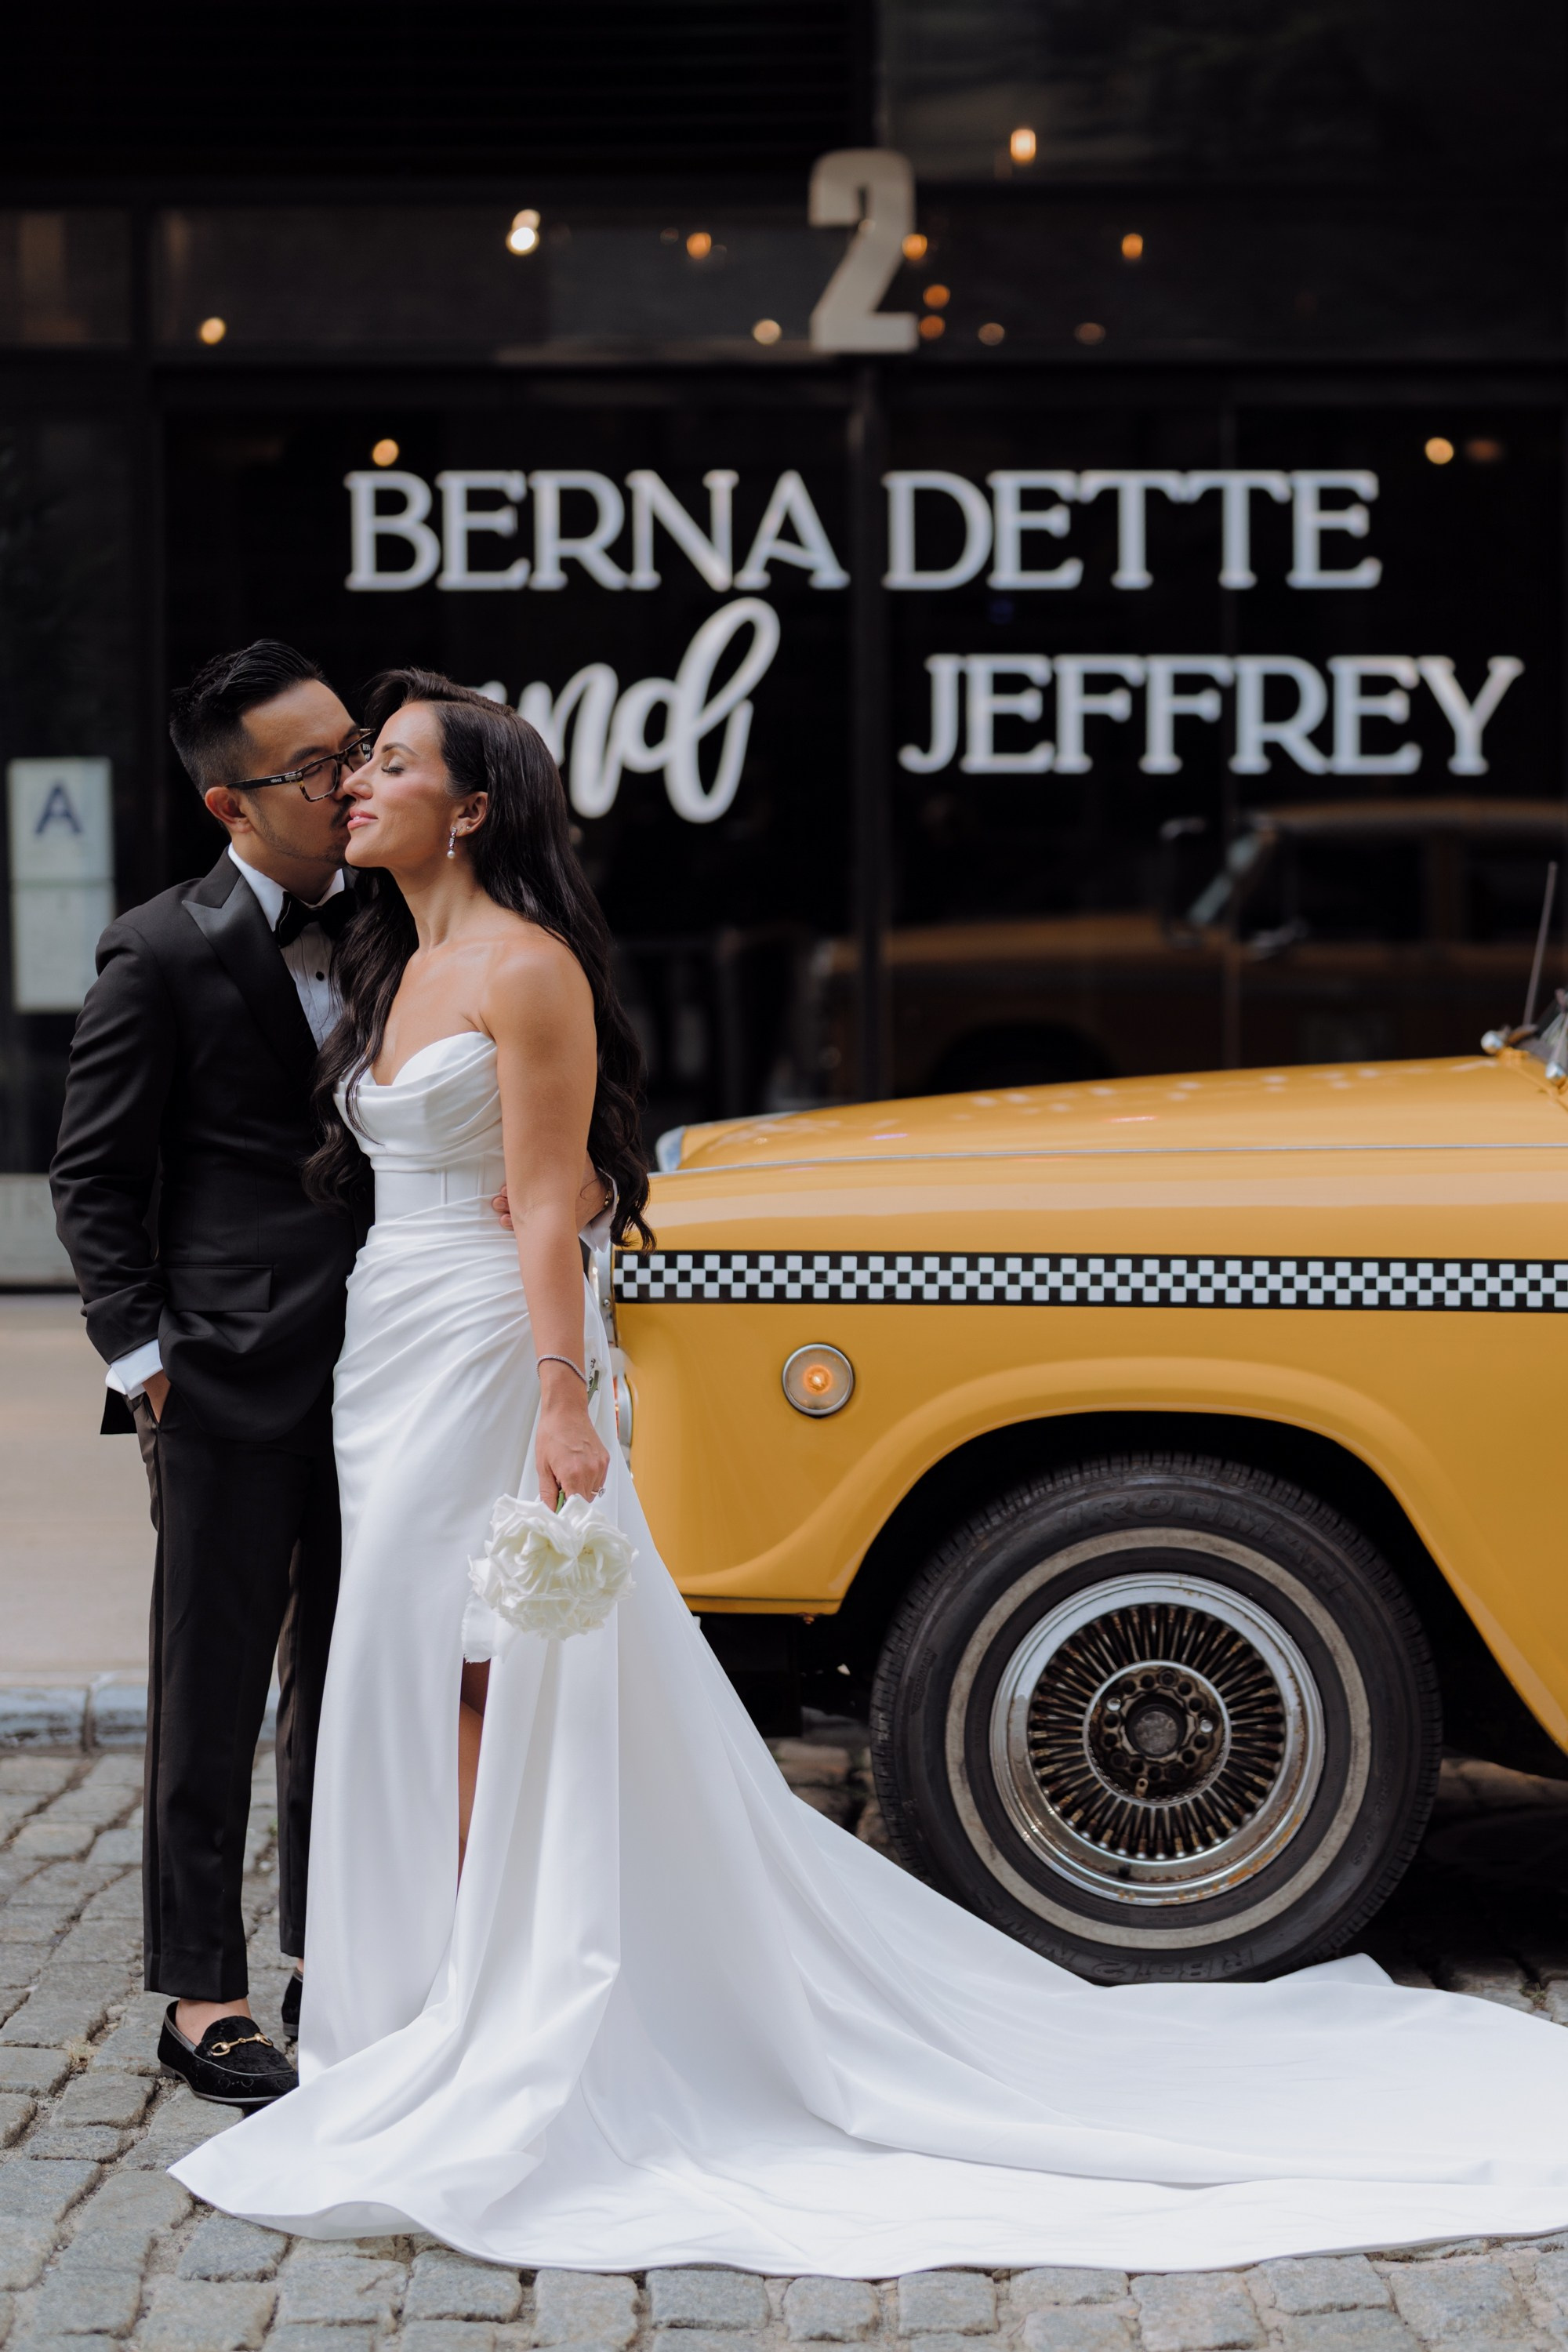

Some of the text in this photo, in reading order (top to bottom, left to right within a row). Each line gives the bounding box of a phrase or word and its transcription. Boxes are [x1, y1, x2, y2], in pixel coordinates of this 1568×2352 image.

[808, 148, 918, 353] 2
[472, 597, 1524, 823] nd JEFFREY
[35, 781, 82, 834] A
[1063, 1491, 1350, 1601] IRONMAN
